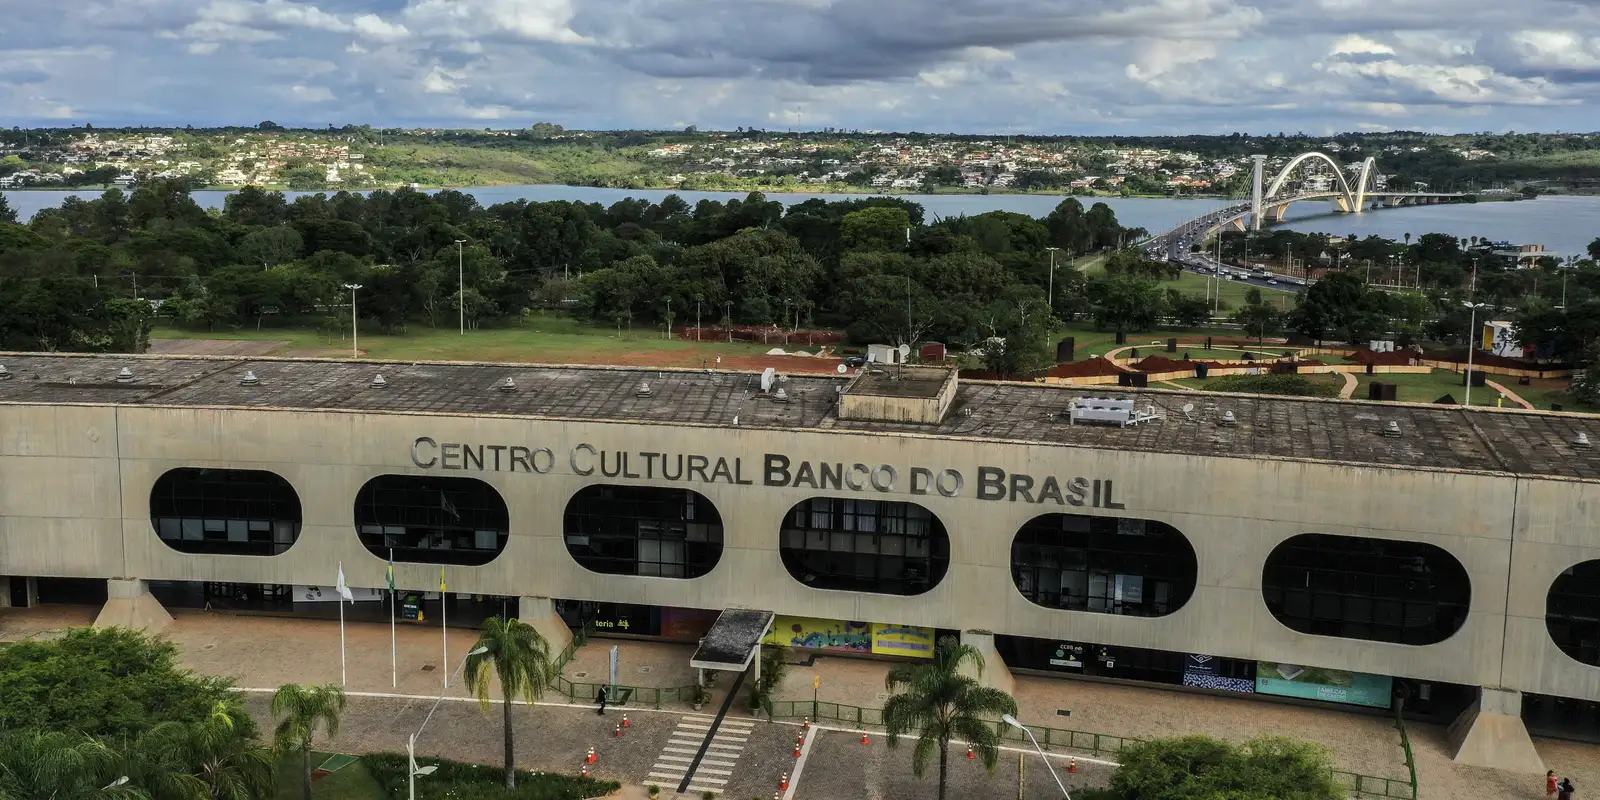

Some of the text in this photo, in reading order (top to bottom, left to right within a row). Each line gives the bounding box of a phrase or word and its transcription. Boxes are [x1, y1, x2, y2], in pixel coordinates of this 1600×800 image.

[411, 436, 1125, 510] CENTRO CULTURAL BANCO DO BRASIL
